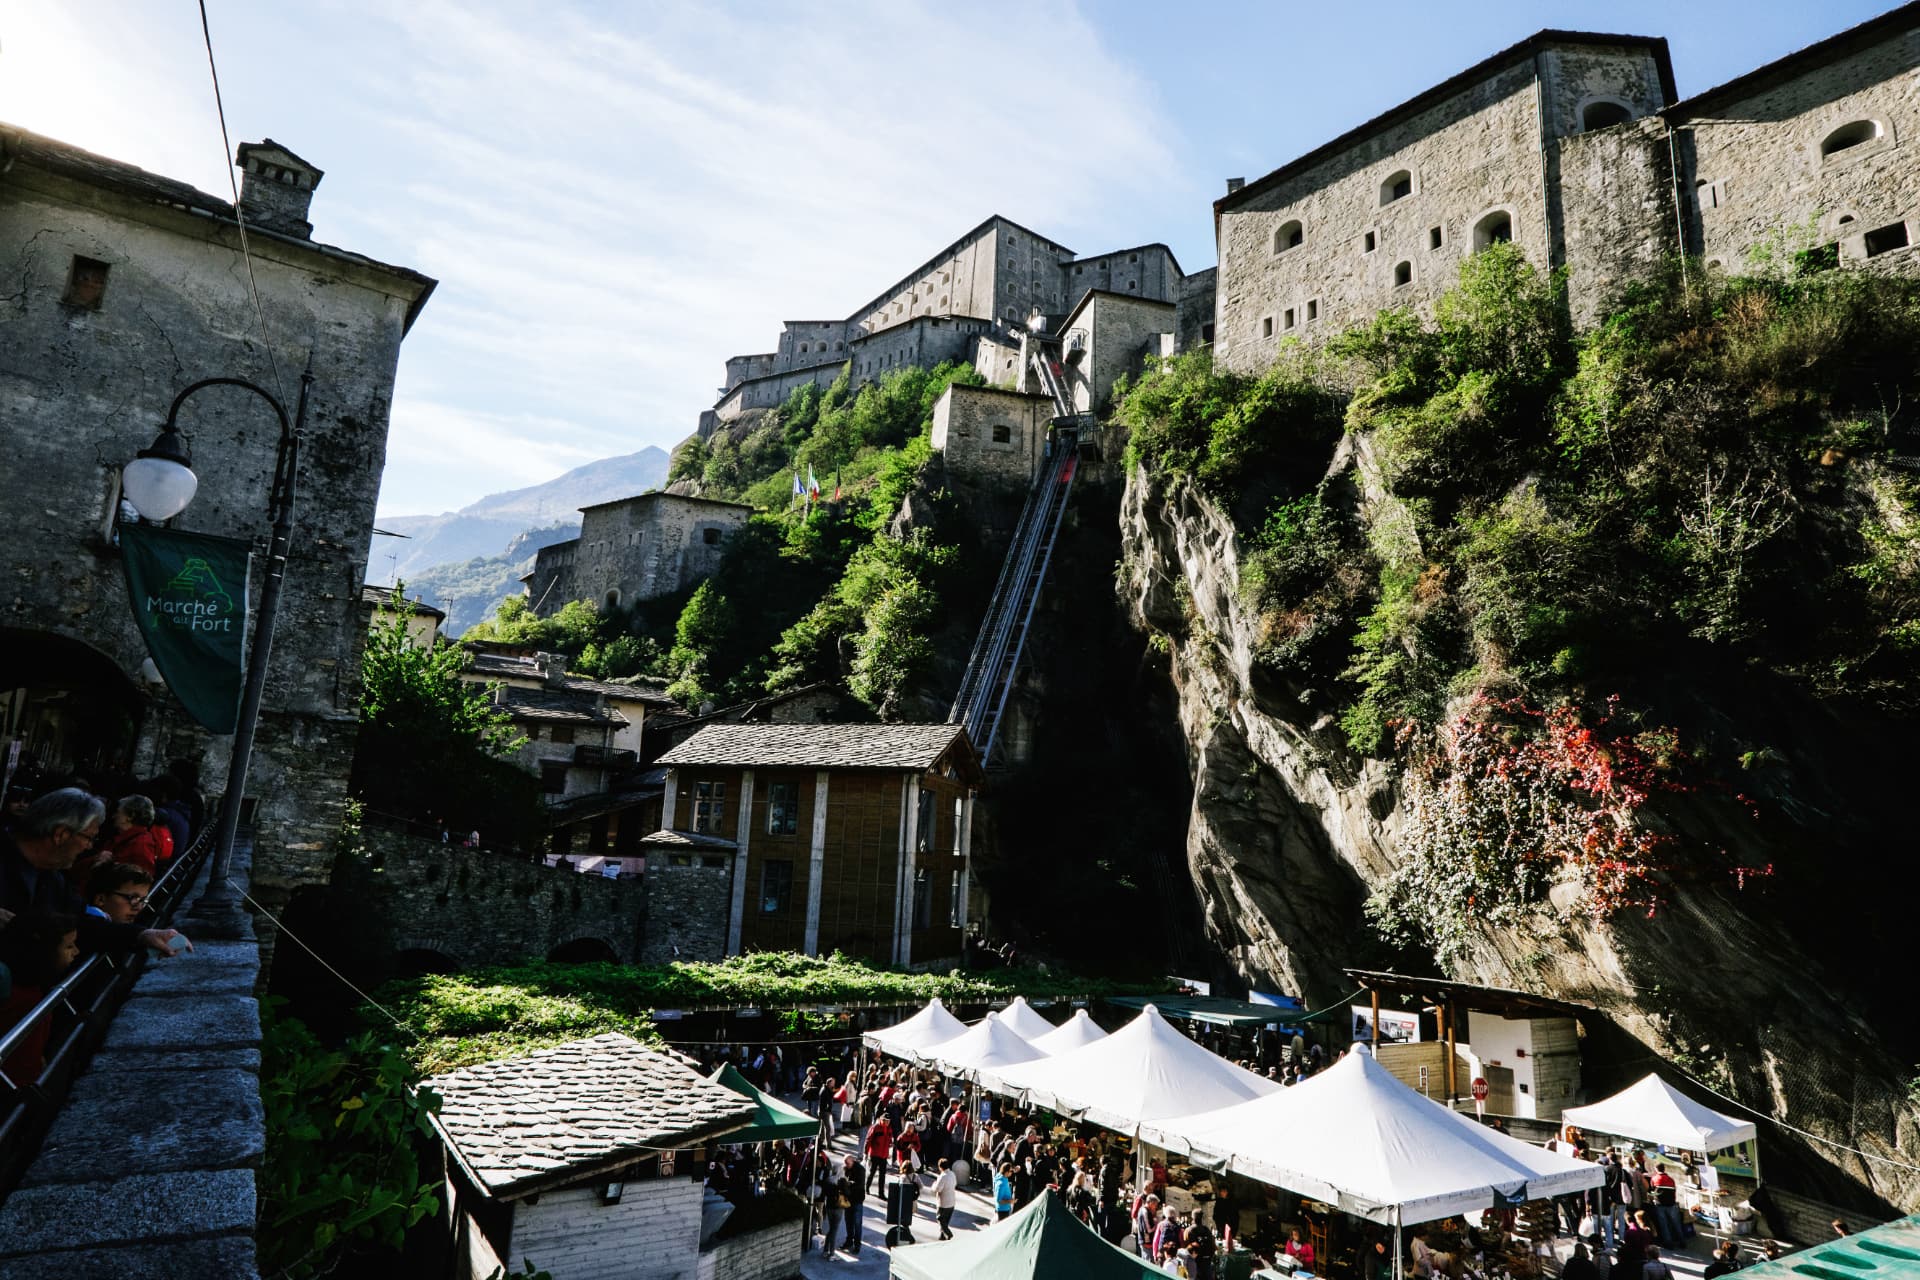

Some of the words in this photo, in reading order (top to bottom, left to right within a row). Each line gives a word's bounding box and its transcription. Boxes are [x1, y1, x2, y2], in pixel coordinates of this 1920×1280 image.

[147, 596, 218, 616] Marché
[173, 616, 189, 625] au
[192, 616, 231, 632] Fort
[1473, 1084, 1488, 1094] STOP
